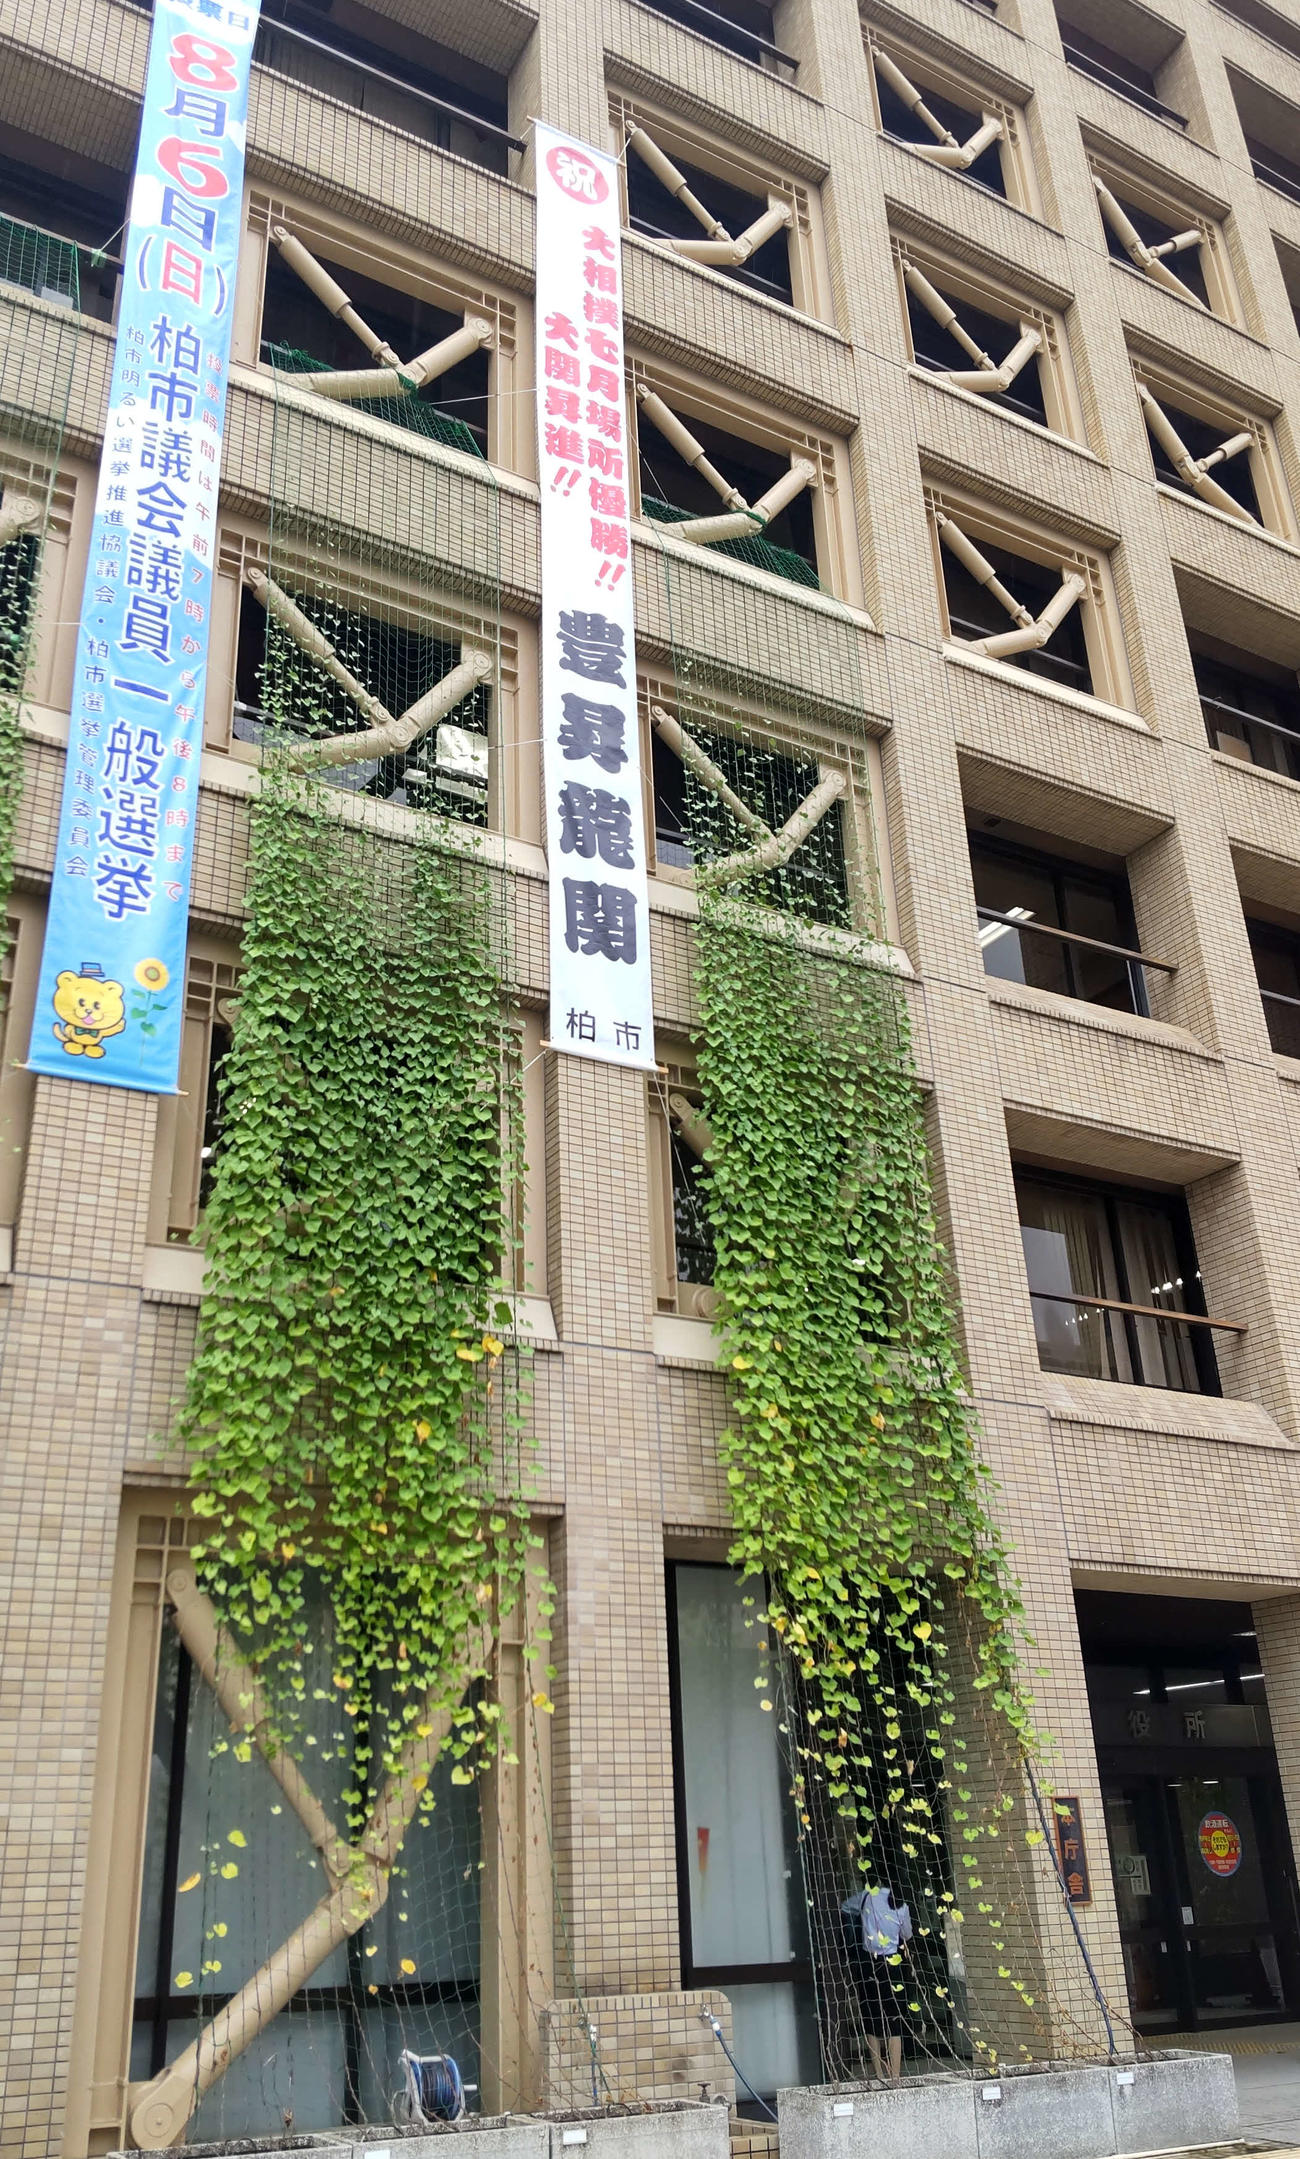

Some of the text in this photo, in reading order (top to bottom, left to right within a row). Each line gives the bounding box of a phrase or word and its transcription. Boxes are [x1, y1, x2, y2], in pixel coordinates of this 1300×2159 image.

[556, 150, 600, 202] 祝
[97, 315, 201, 919] 柏市議会議員一般選挙
[556, 609, 639, 966] 豊昇龍関
